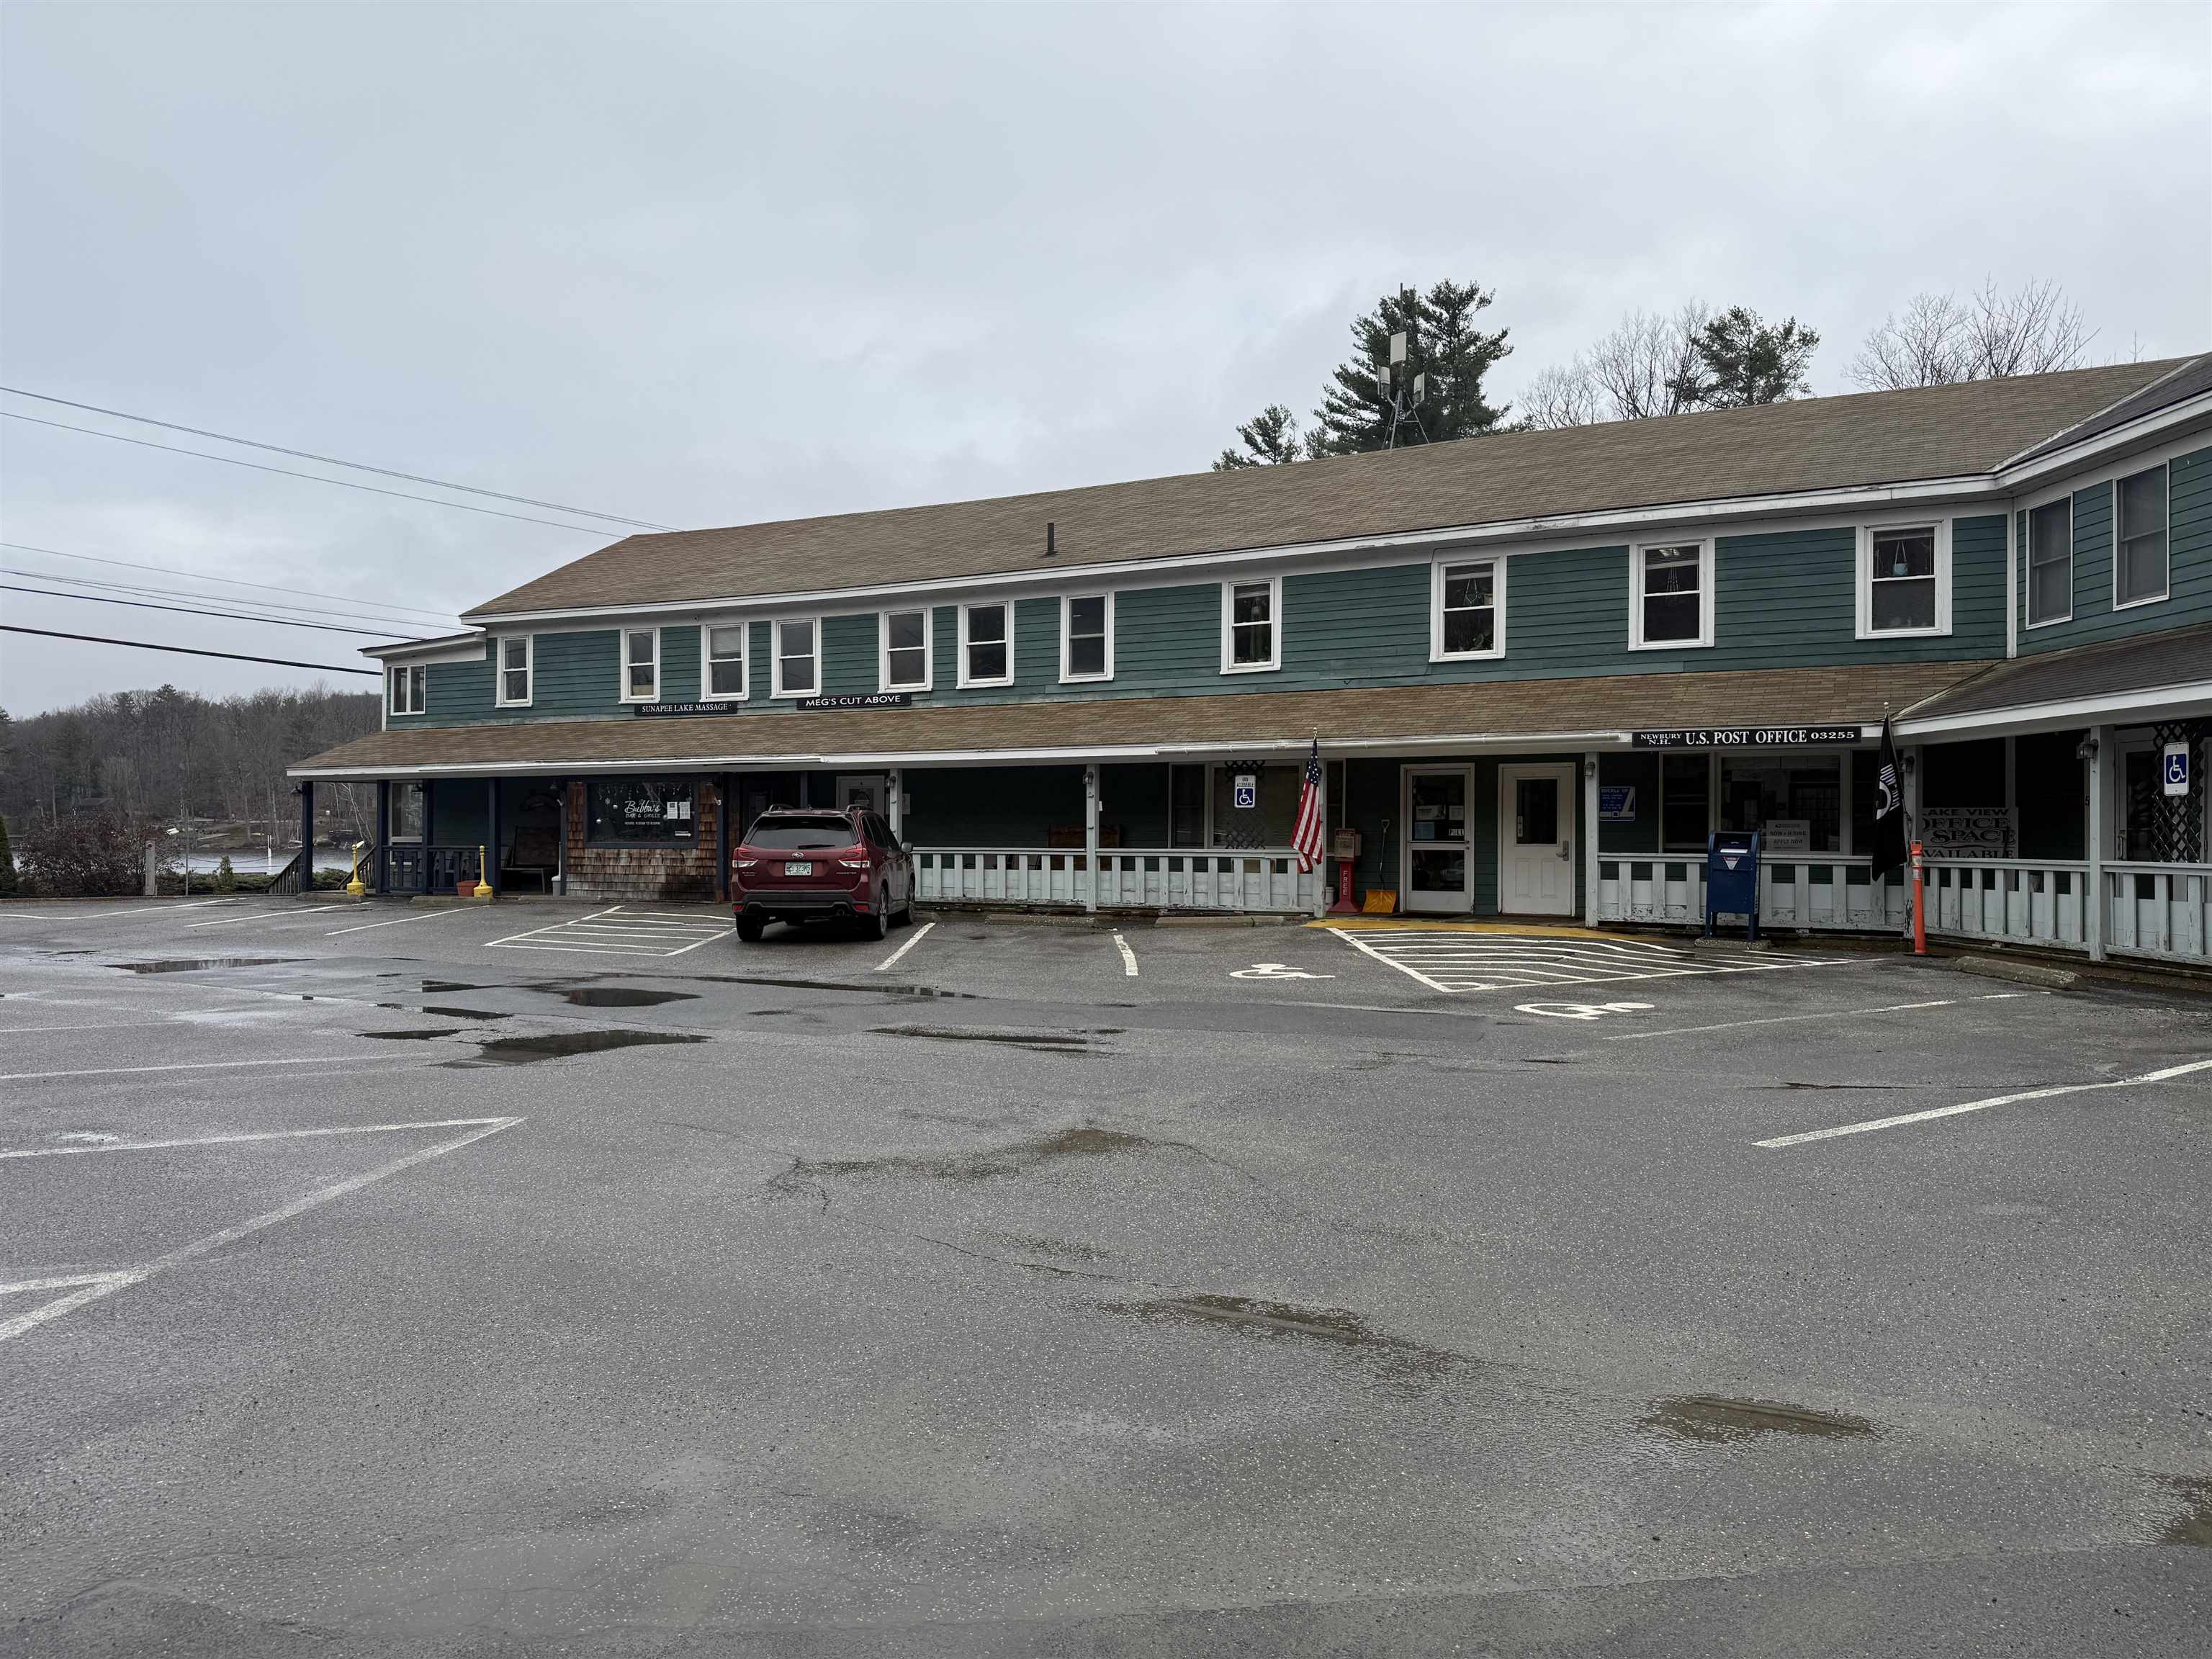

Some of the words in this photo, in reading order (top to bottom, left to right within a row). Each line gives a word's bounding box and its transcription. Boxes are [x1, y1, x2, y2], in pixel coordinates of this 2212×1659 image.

[806, 698, 837, 706] MEG'S
[865, 695, 901, 704] ABOVE
[1686, 732, 1710, 745] U.S.
[1713, 731, 1750, 745] POST
[1755, 729, 1807, 743] OFFICE
[1810, 731, 1855, 739] 03255
[624, 800, 661, 813] Bubba's
[1930, 830, 2016, 845] SPACE
[1923, 850, 2014, 859] VAILABLE
